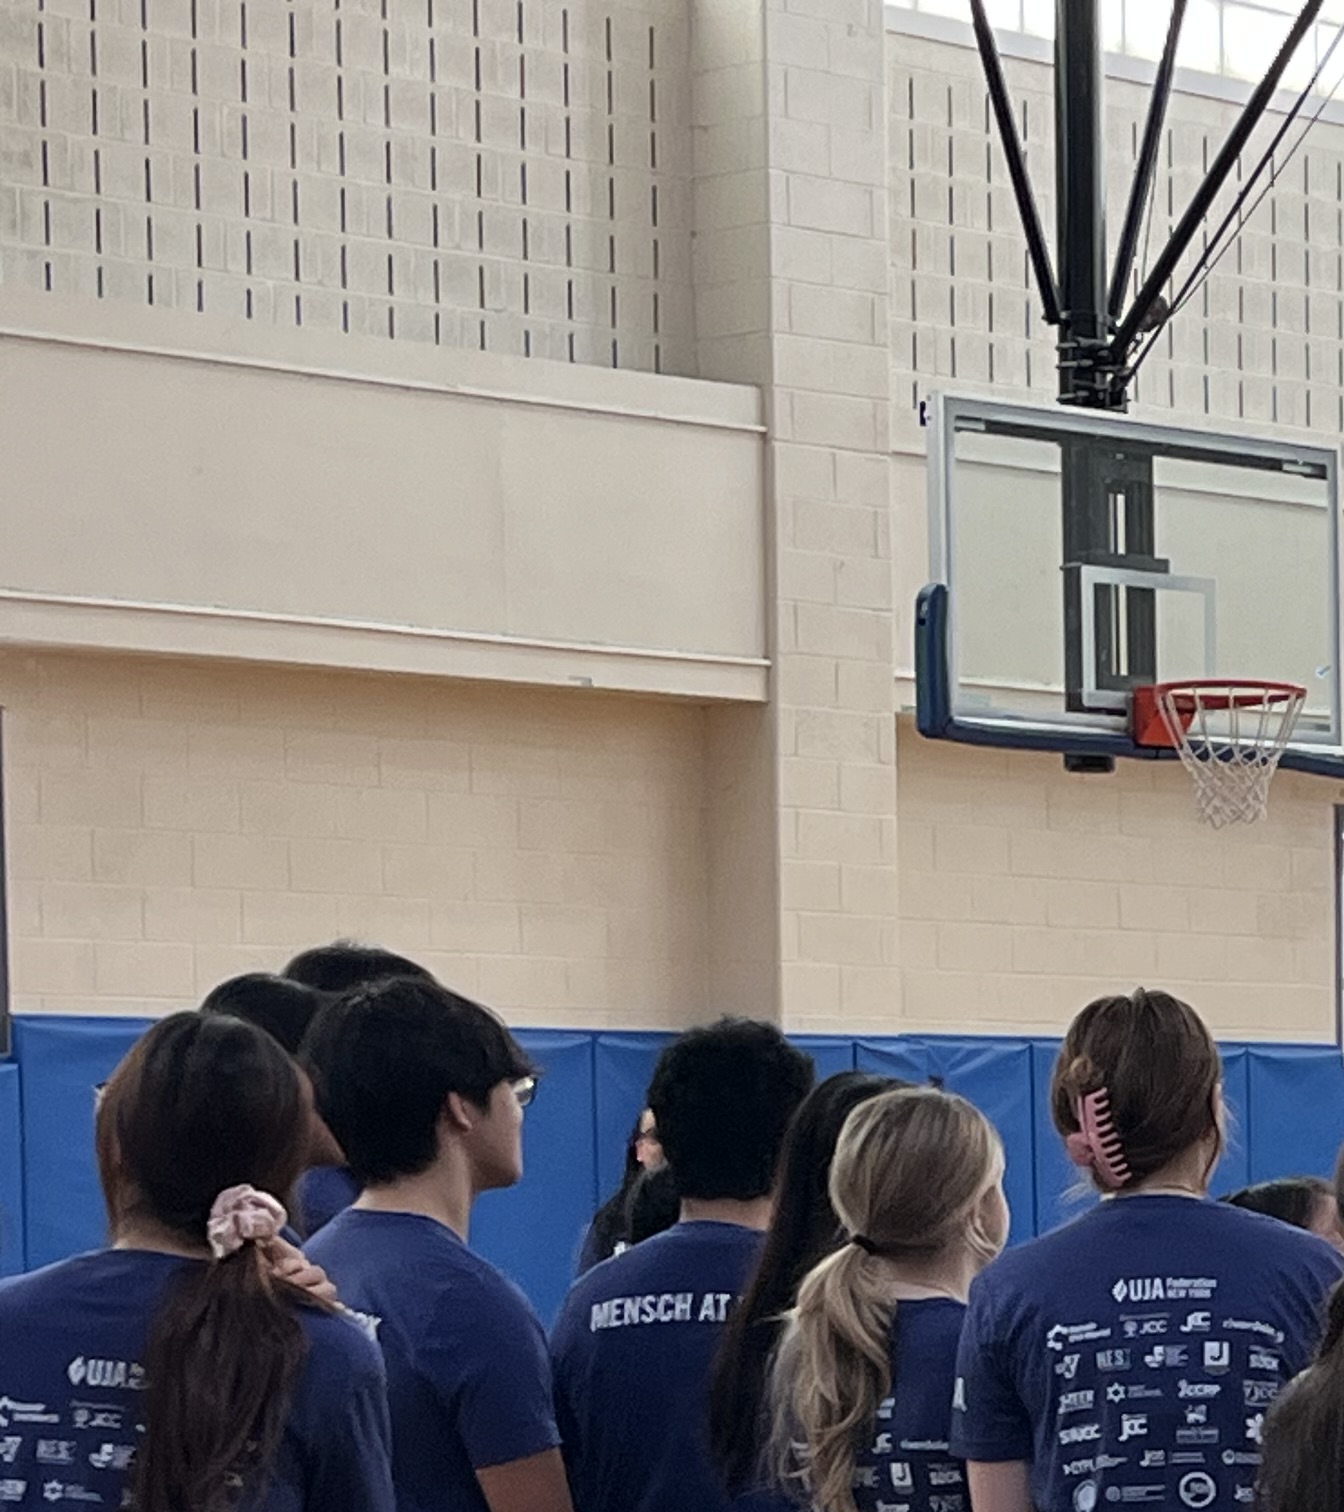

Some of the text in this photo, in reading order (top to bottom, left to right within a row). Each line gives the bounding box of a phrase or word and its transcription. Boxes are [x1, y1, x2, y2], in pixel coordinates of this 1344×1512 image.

[1128, 1277, 1165, 1301] UJA
[590, 1292, 732, 1332] MENSCH AT
[1139, 1320, 1168, 1335] JCC
[86, 1358, 127, 1387] UJA
